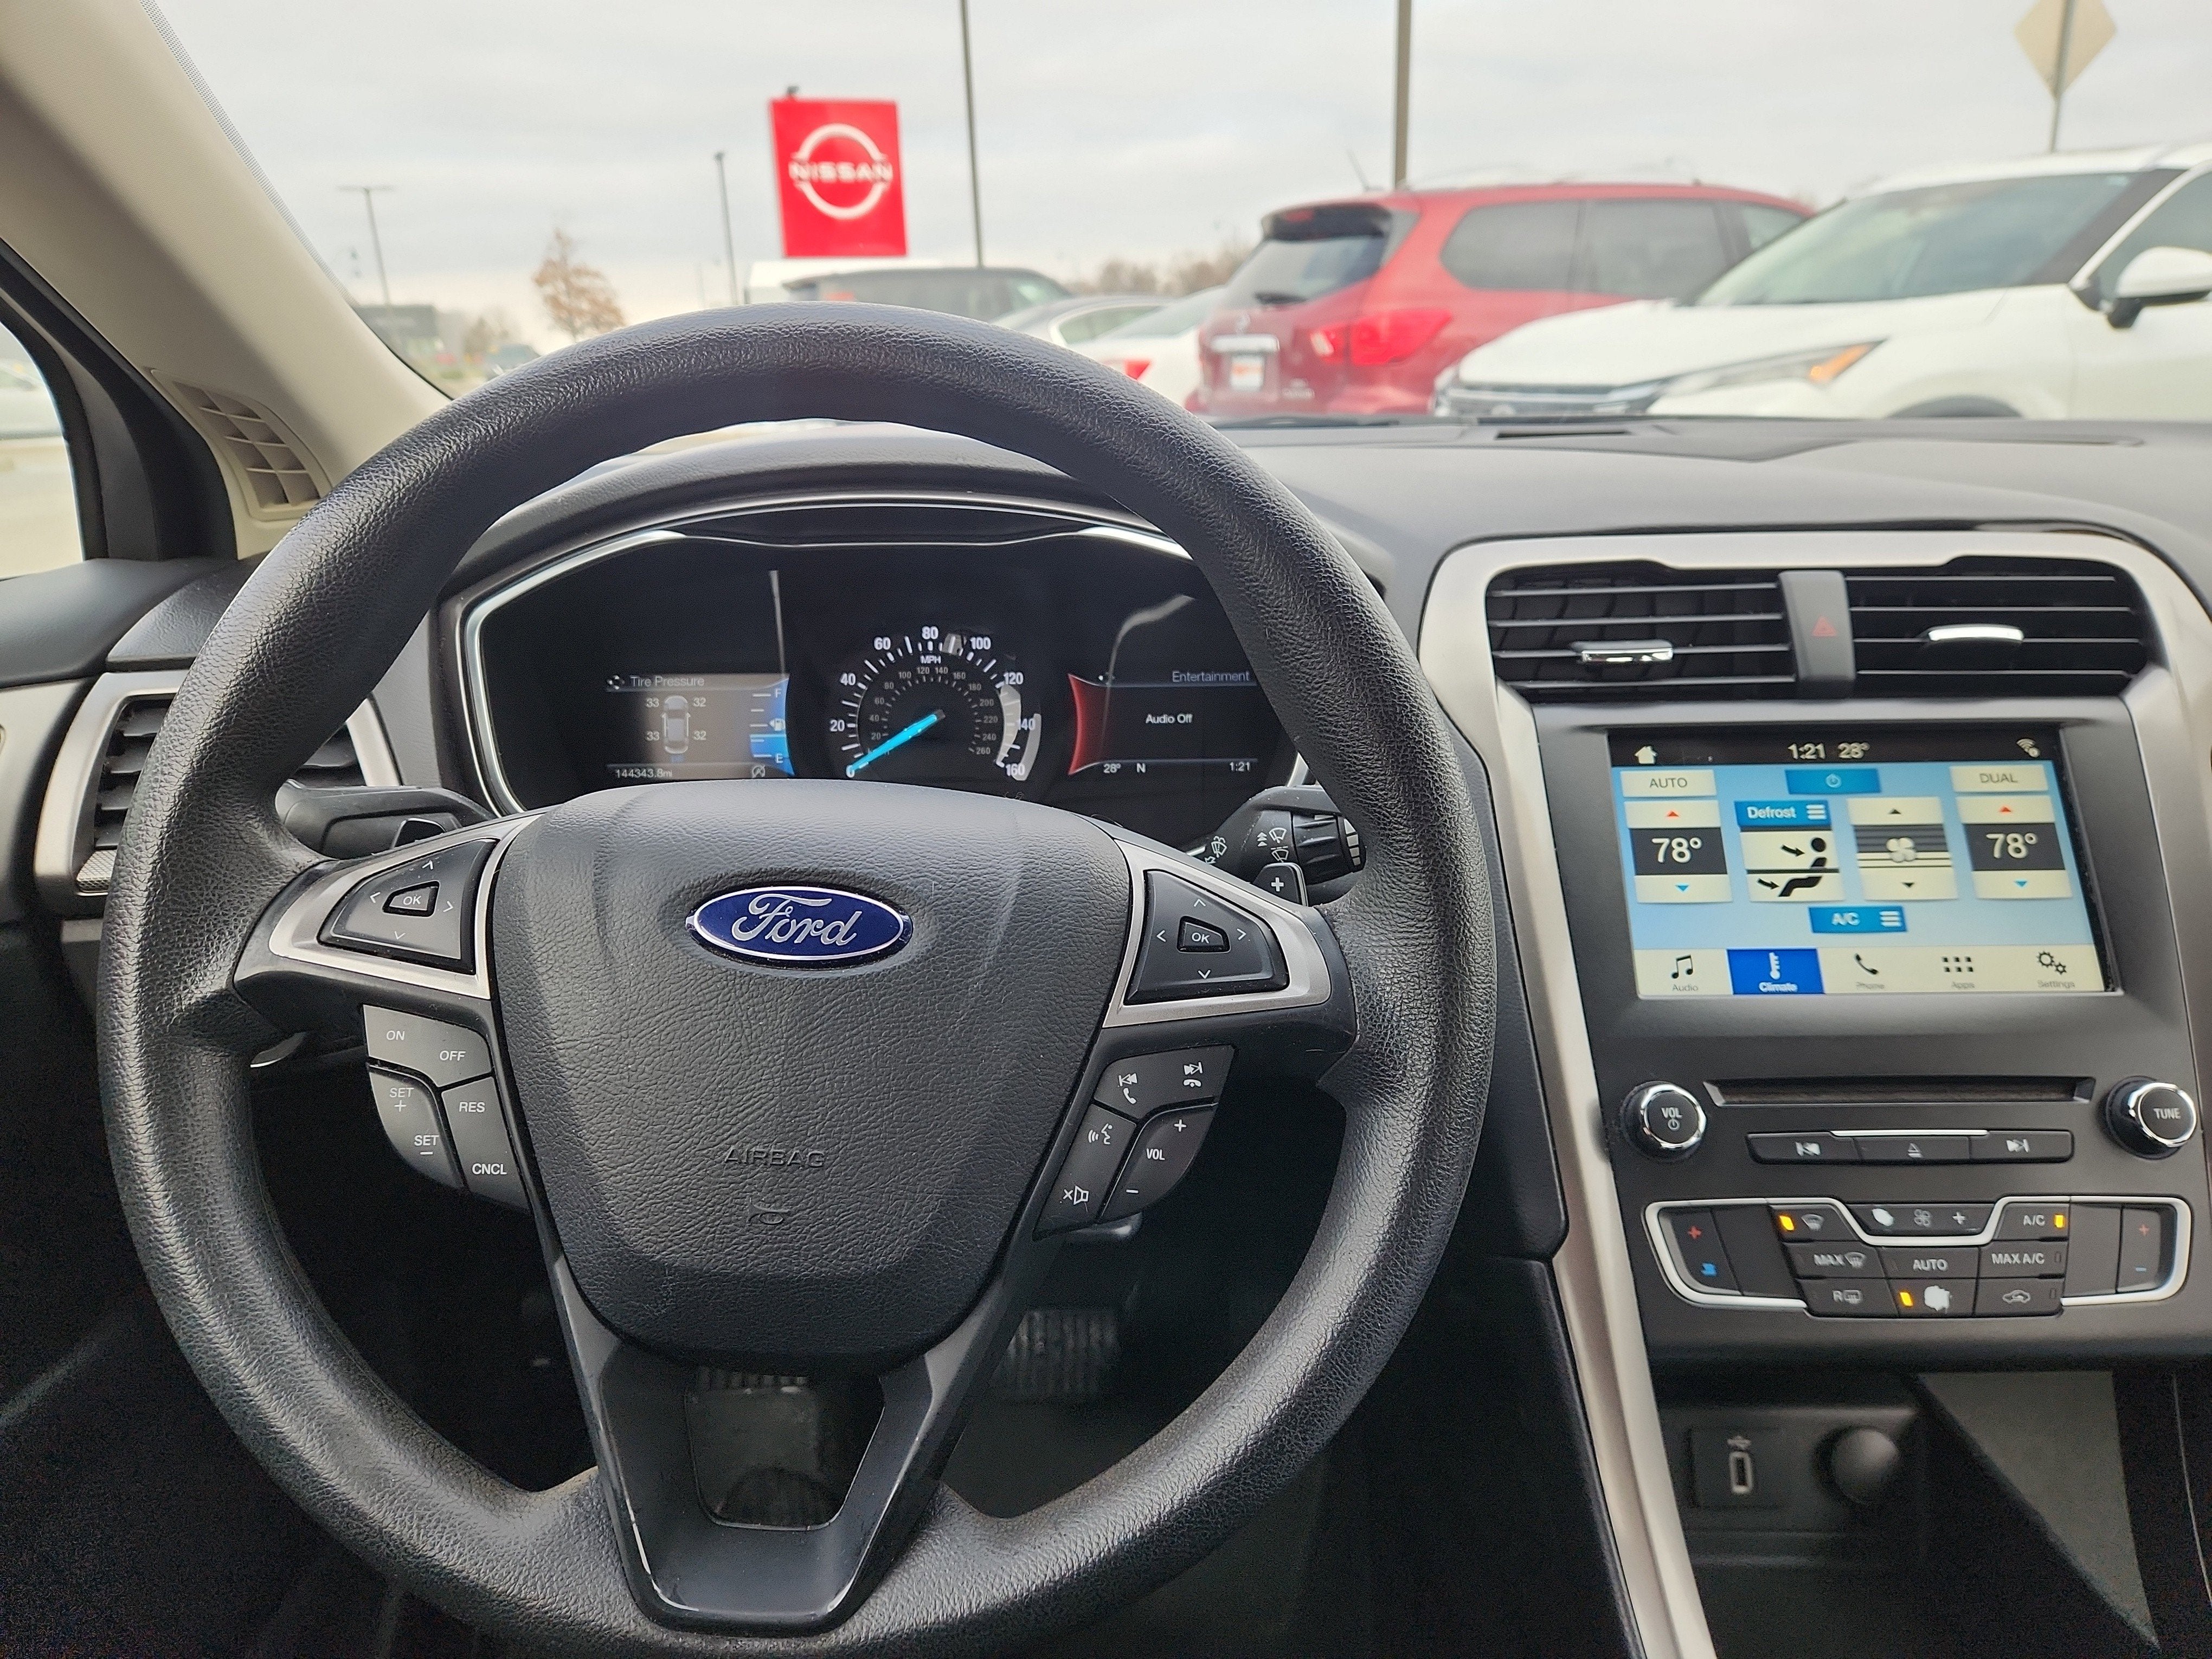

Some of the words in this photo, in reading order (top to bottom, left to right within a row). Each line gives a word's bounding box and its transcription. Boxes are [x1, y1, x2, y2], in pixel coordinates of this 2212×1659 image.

[788, 162, 893, 183] NISSAN
[922, 626, 938, 639] 80
[874, 637, 891, 650] 60
[970, 637, 991, 650] 100
[920, 655, 941, 664] MPH
[630, 676, 651, 687] Tire
[654, 676, 705, 687] Pressure
[840, 673, 856, 686] 40
[1004, 672, 1024, 685] 120
[1172, 671, 1250, 683] Entertainment
[775, 689, 782, 698] F
[647, 698, 659, 708] 33
[693, 697, 706, 707] 32
[983, 716, 998, 724] 220
[1018, 718, 1035, 731] 140
[1146, 713, 1175, 724] Audio
[1177, 713, 1193, 724] Off
[830, 719, 845, 732] 20
[647, 731, 659, 741] 33
[694, 731, 706, 740] 32
[982, 733, 996, 741] 240
[976, 747, 991, 755] 260
[1788, 743, 1825, 760] 1:21
[776, 754, 783, 763] E
[846, 765, 854, 778] 0
[1005, 764, 1025, 776] 160
[1137, 764, 1146, 773] N
[1229, 762, 1250, 771] 1:21
[1649, 777, 1688, 789] AUTO
[1979, 773, 2018, 784] DUAL
[1747, 806, 1797, 819] Defrost
[1652, 837, 1702, 864] 78°
[1985, 832, 2038, 859] 78°
[403, 895, 422, 905] OK
[731, 893, 863, 946] Ford
[1831, 912, 1860, 927] A/C
[1192, 933, 1211, 944] OK
[1671, 983, 1699, 992] Audio
[1758, 981, 1798, 993] Climate
[386, 1031, 405, 1041] ON
[439, 1050, 466, 1061] OFF
[389, 1087, 414, 1098] SET
[459, 1102, 485, 1113] RES
[1662, 1107, 1682, 1118] VOL
[2153, 1108, 2181, 1120] TUNE
[414, 1135, 439, 1146] SET
[724, 1148, 825, 1168] AIRBAG
[1146, 1148, 1165, 1161] VOL
[472, 1163, 507, 1175] CNCL
[2023, 1214, 2046, 1226] A/C
[1814, 1253, 1844, 1267] MAX
[1991, 1253, 2021, 1264] MAX
[2022, 1252, 2046, 1264] A/C
[1913, 1259, 1948, 1271] AUTO
